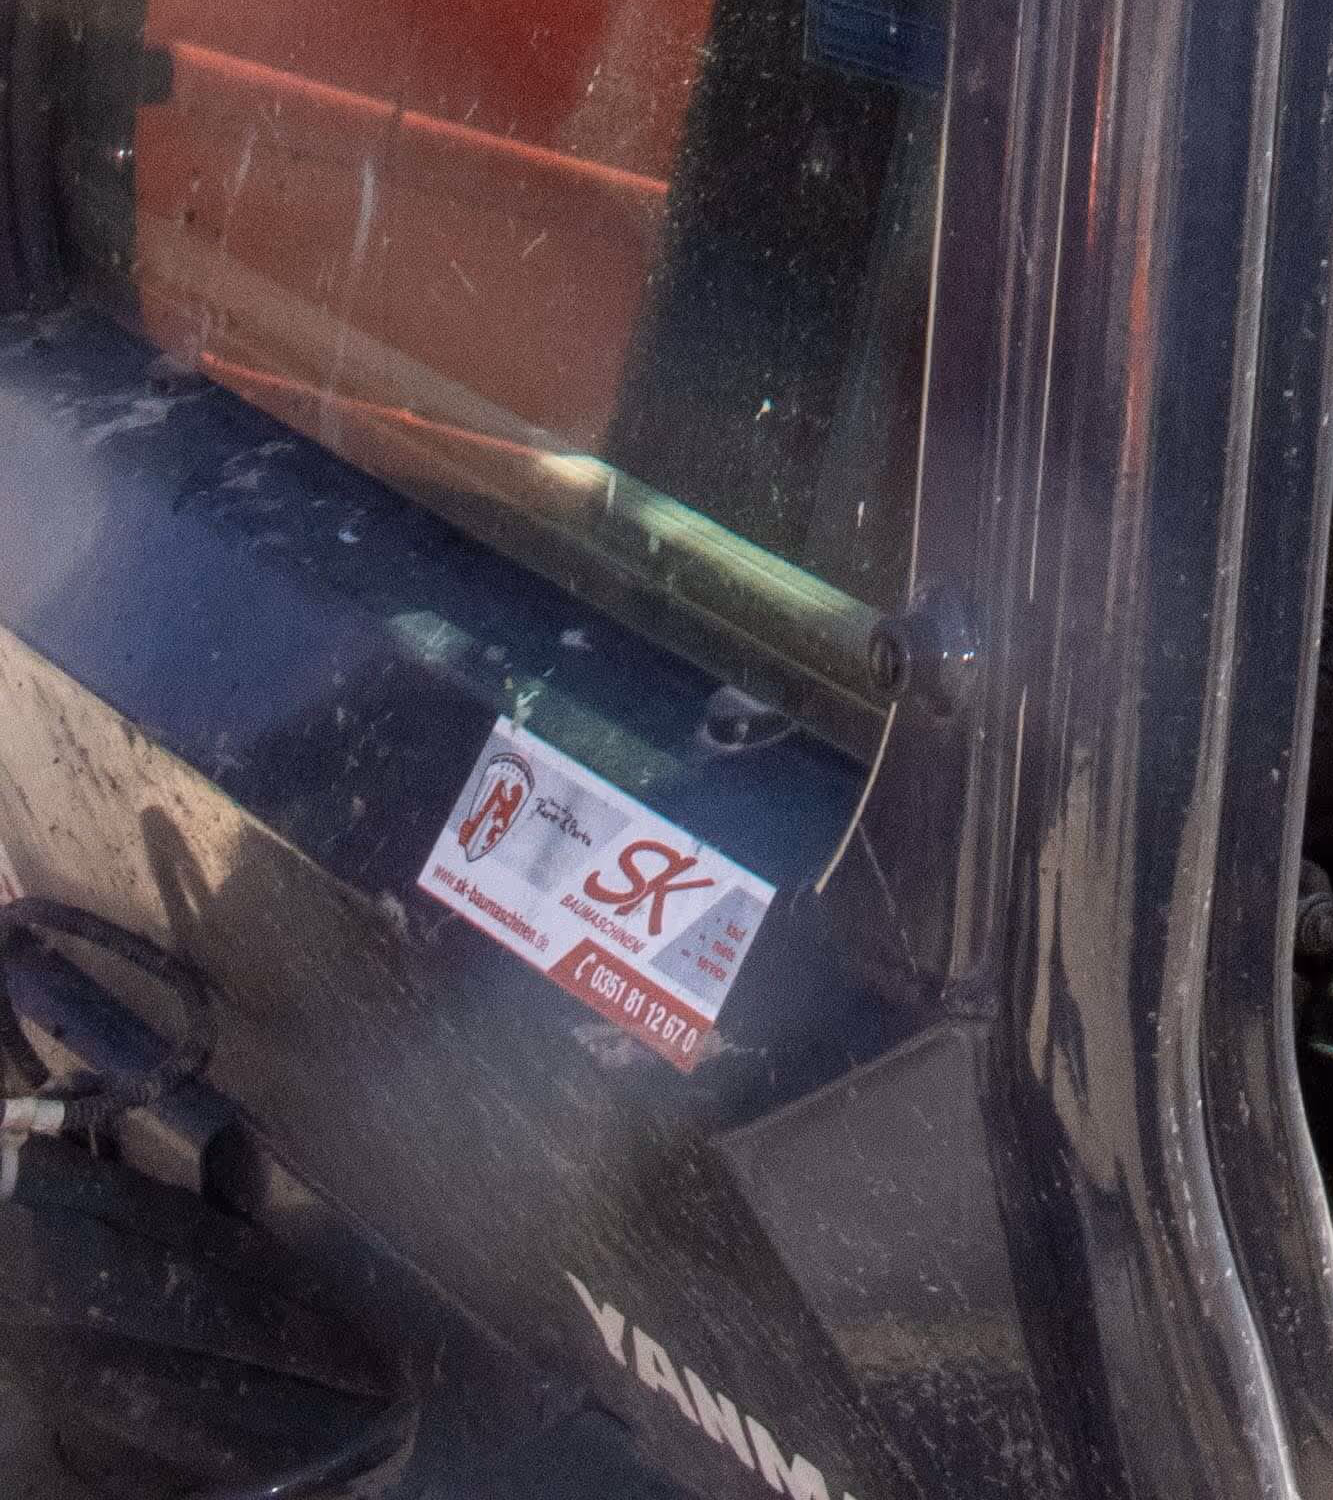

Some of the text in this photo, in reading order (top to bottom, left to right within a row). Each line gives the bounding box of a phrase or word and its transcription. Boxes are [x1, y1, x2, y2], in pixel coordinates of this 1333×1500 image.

[432, 863, 550, 953] www.sk-baumaschinen.de
[582, 839, 716, 937] SK
[589, 964, 698, 1053] 0351 81 12 67 0
[565, 1270, 858, 1500] YANM
